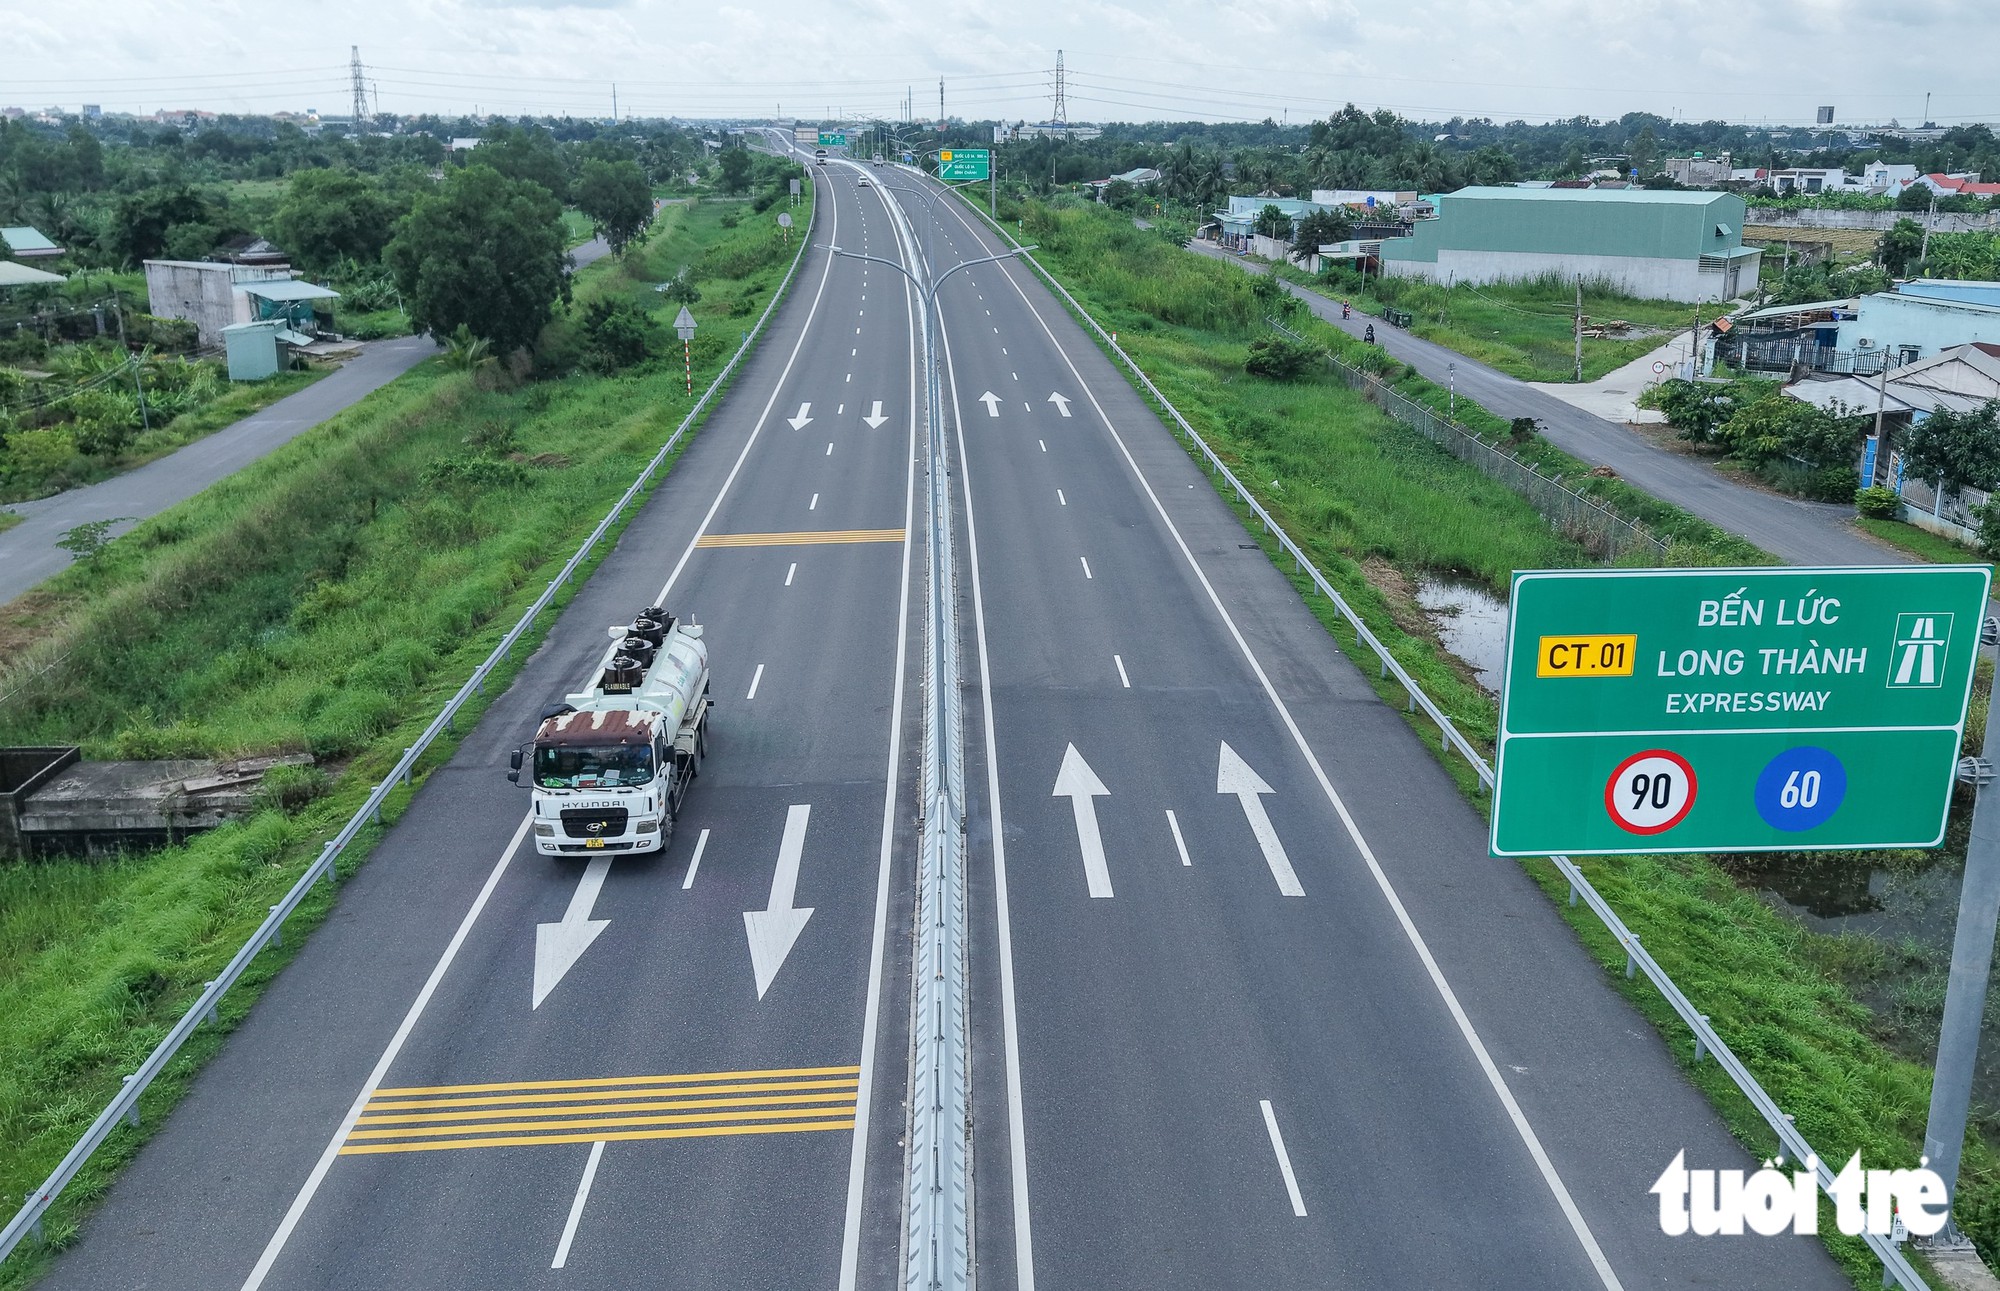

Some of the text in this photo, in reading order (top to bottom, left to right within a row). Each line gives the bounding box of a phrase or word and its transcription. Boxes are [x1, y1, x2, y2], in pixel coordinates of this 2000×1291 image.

[1697, 586, 1842, 627] BẾN LỨC
[1548, 642, 1626, 670] CT.01
[1657, 639, 1868, 677] LONG THÀNH
[1665, 690, 1832, 714] EXPRESSWAY
[562, 800, 626, 808] HYUNDAI
[1630, 772, 1672, 810] 90
[1779, 769, 1821, 809] 60
